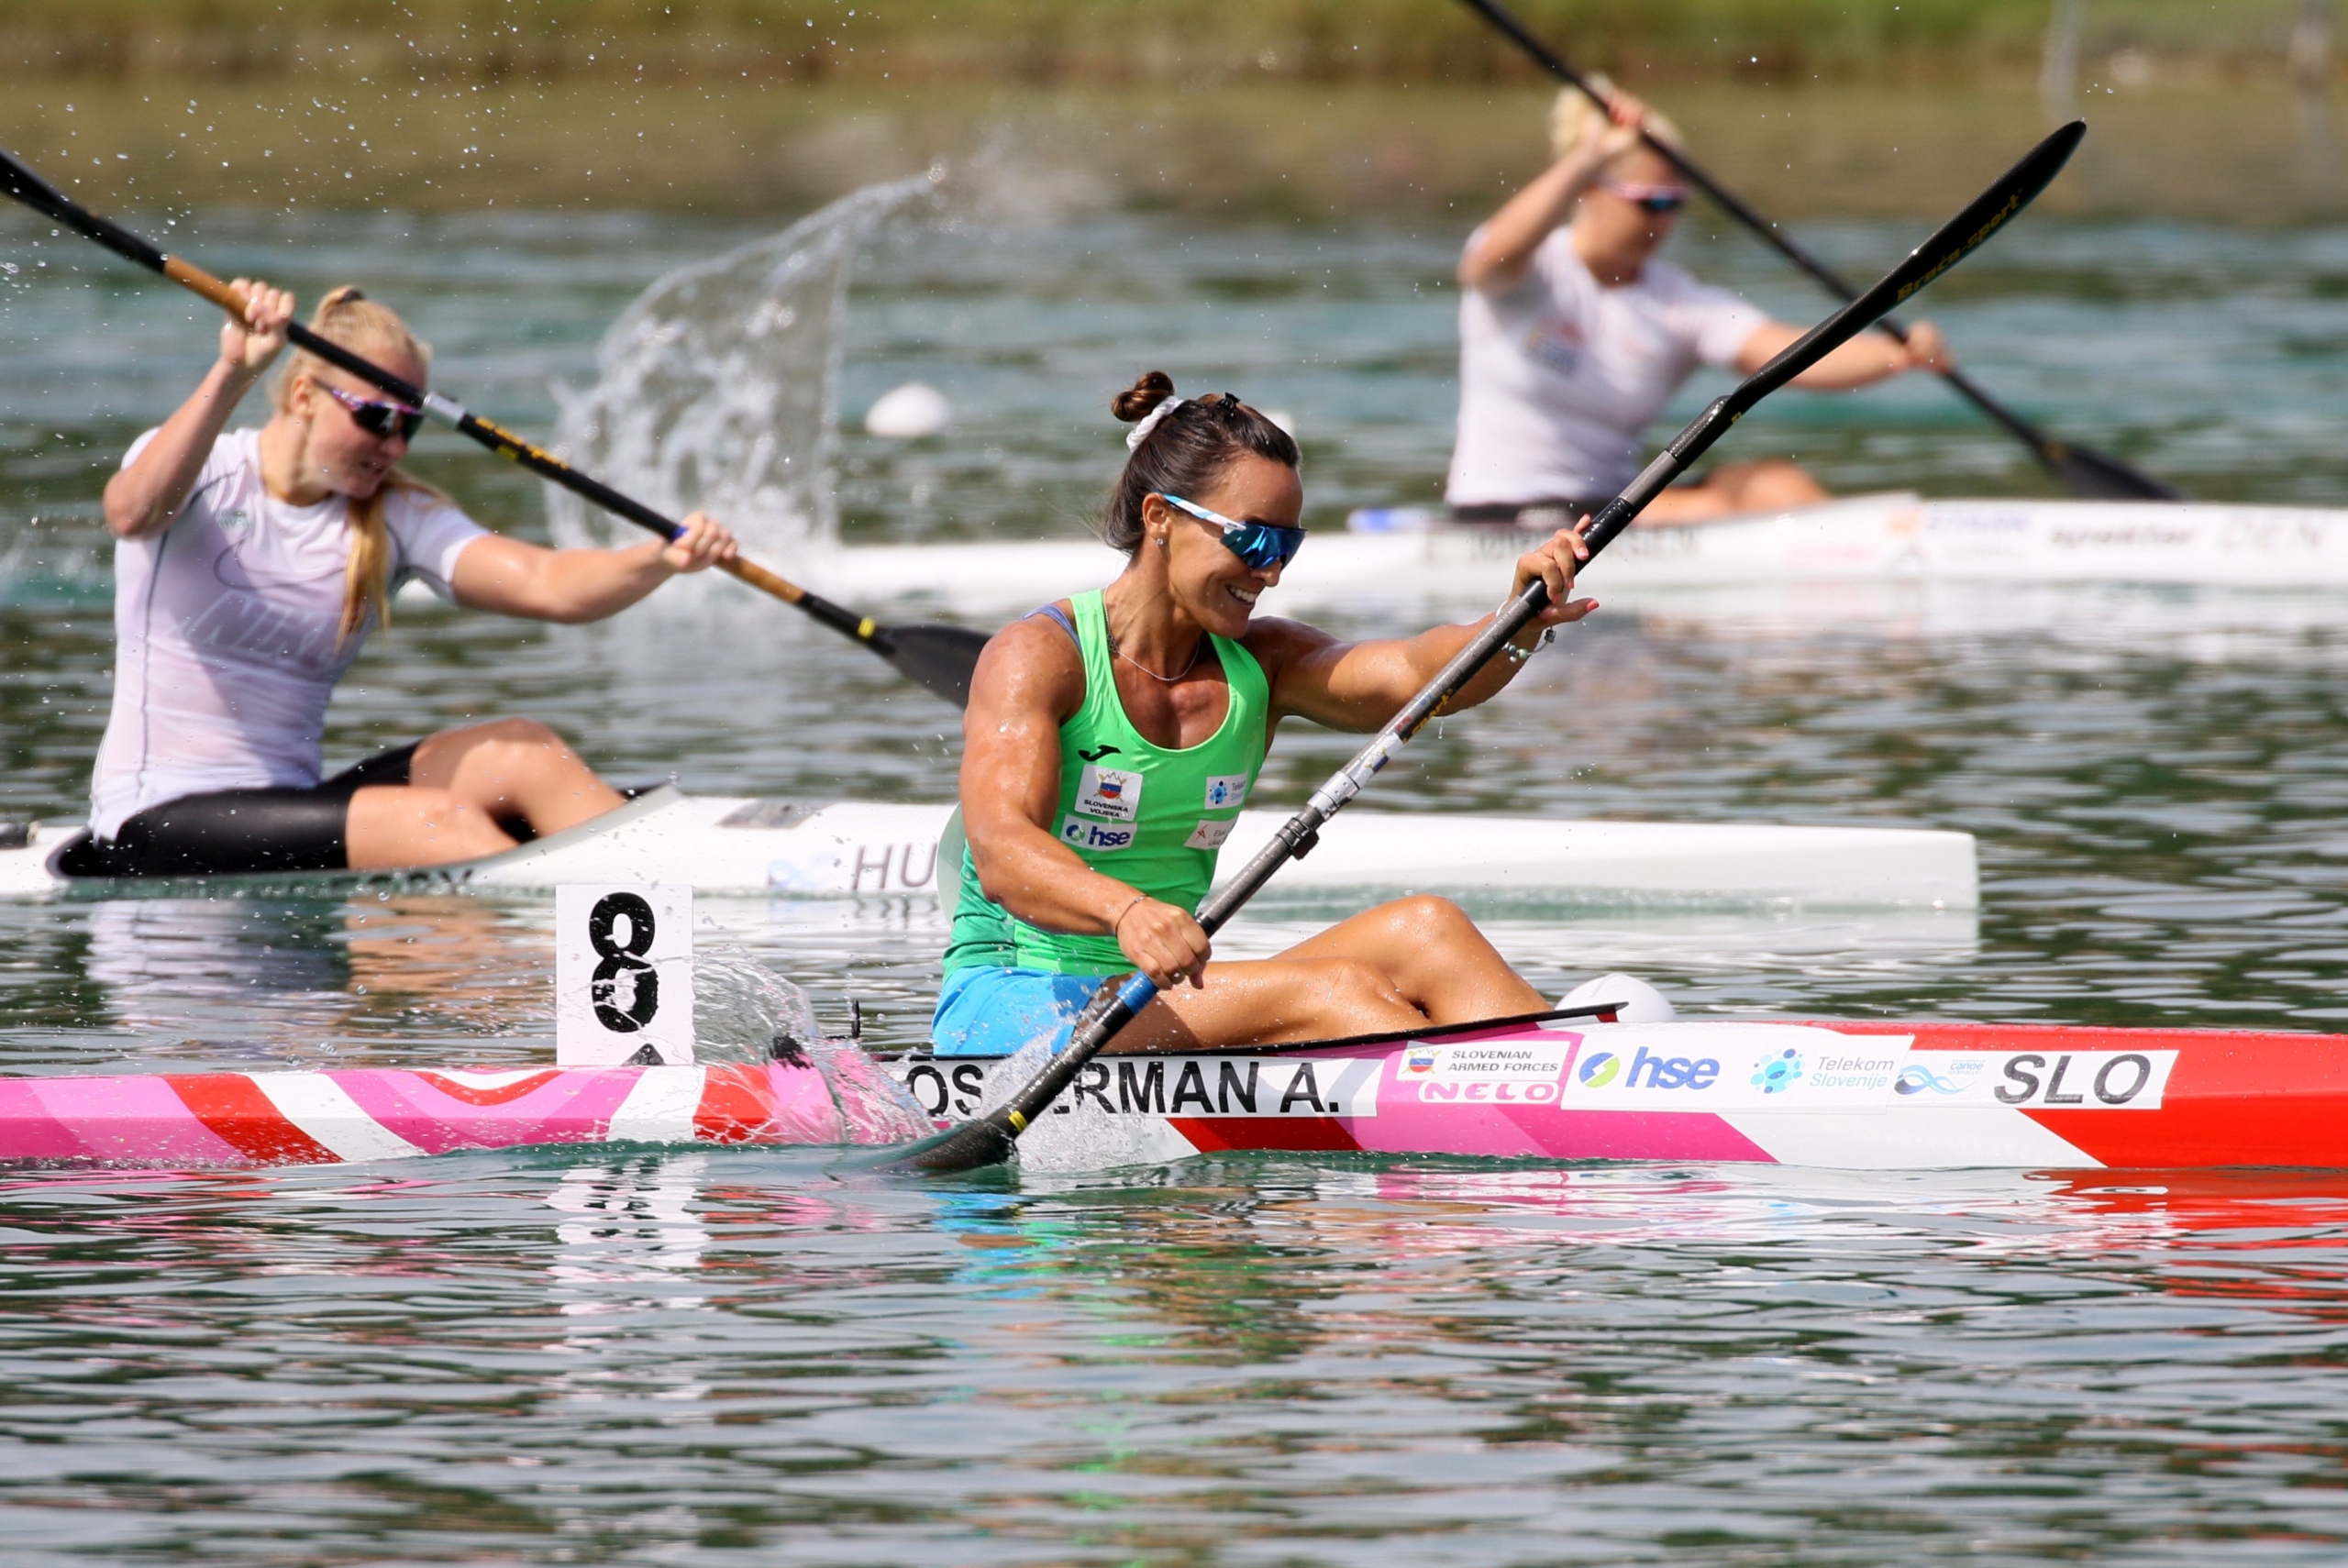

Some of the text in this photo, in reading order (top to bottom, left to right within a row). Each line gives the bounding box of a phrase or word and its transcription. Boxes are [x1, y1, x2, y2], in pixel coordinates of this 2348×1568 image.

[1083, 799, 1129, 812] SLOVENSKA
[1090, 807, 1120, 818] VOJSKA
[1088, 825, 1131, 847] hse
[851, 841, 938, 891] HU
[589, 891, 659, 1033] 8
[1452, 1050, 1533, 1059] SLOVENIAN
[1817, 1055, 1894, 1071] Telekom
[1446, 1062, 1558, 1072] ARMED FORCES
[1624, 1046, 1720, 1090] hse
[1949, 1063, 1984, 1071] canoe
[1809, 1073, 1888, 1091] Slovenije
[1993, 1053, 2152, 1105] SLO
[907, 1061, 1339, 1116] OSRMAN A.
[1423, 1082, 1555, 1100] NELO
